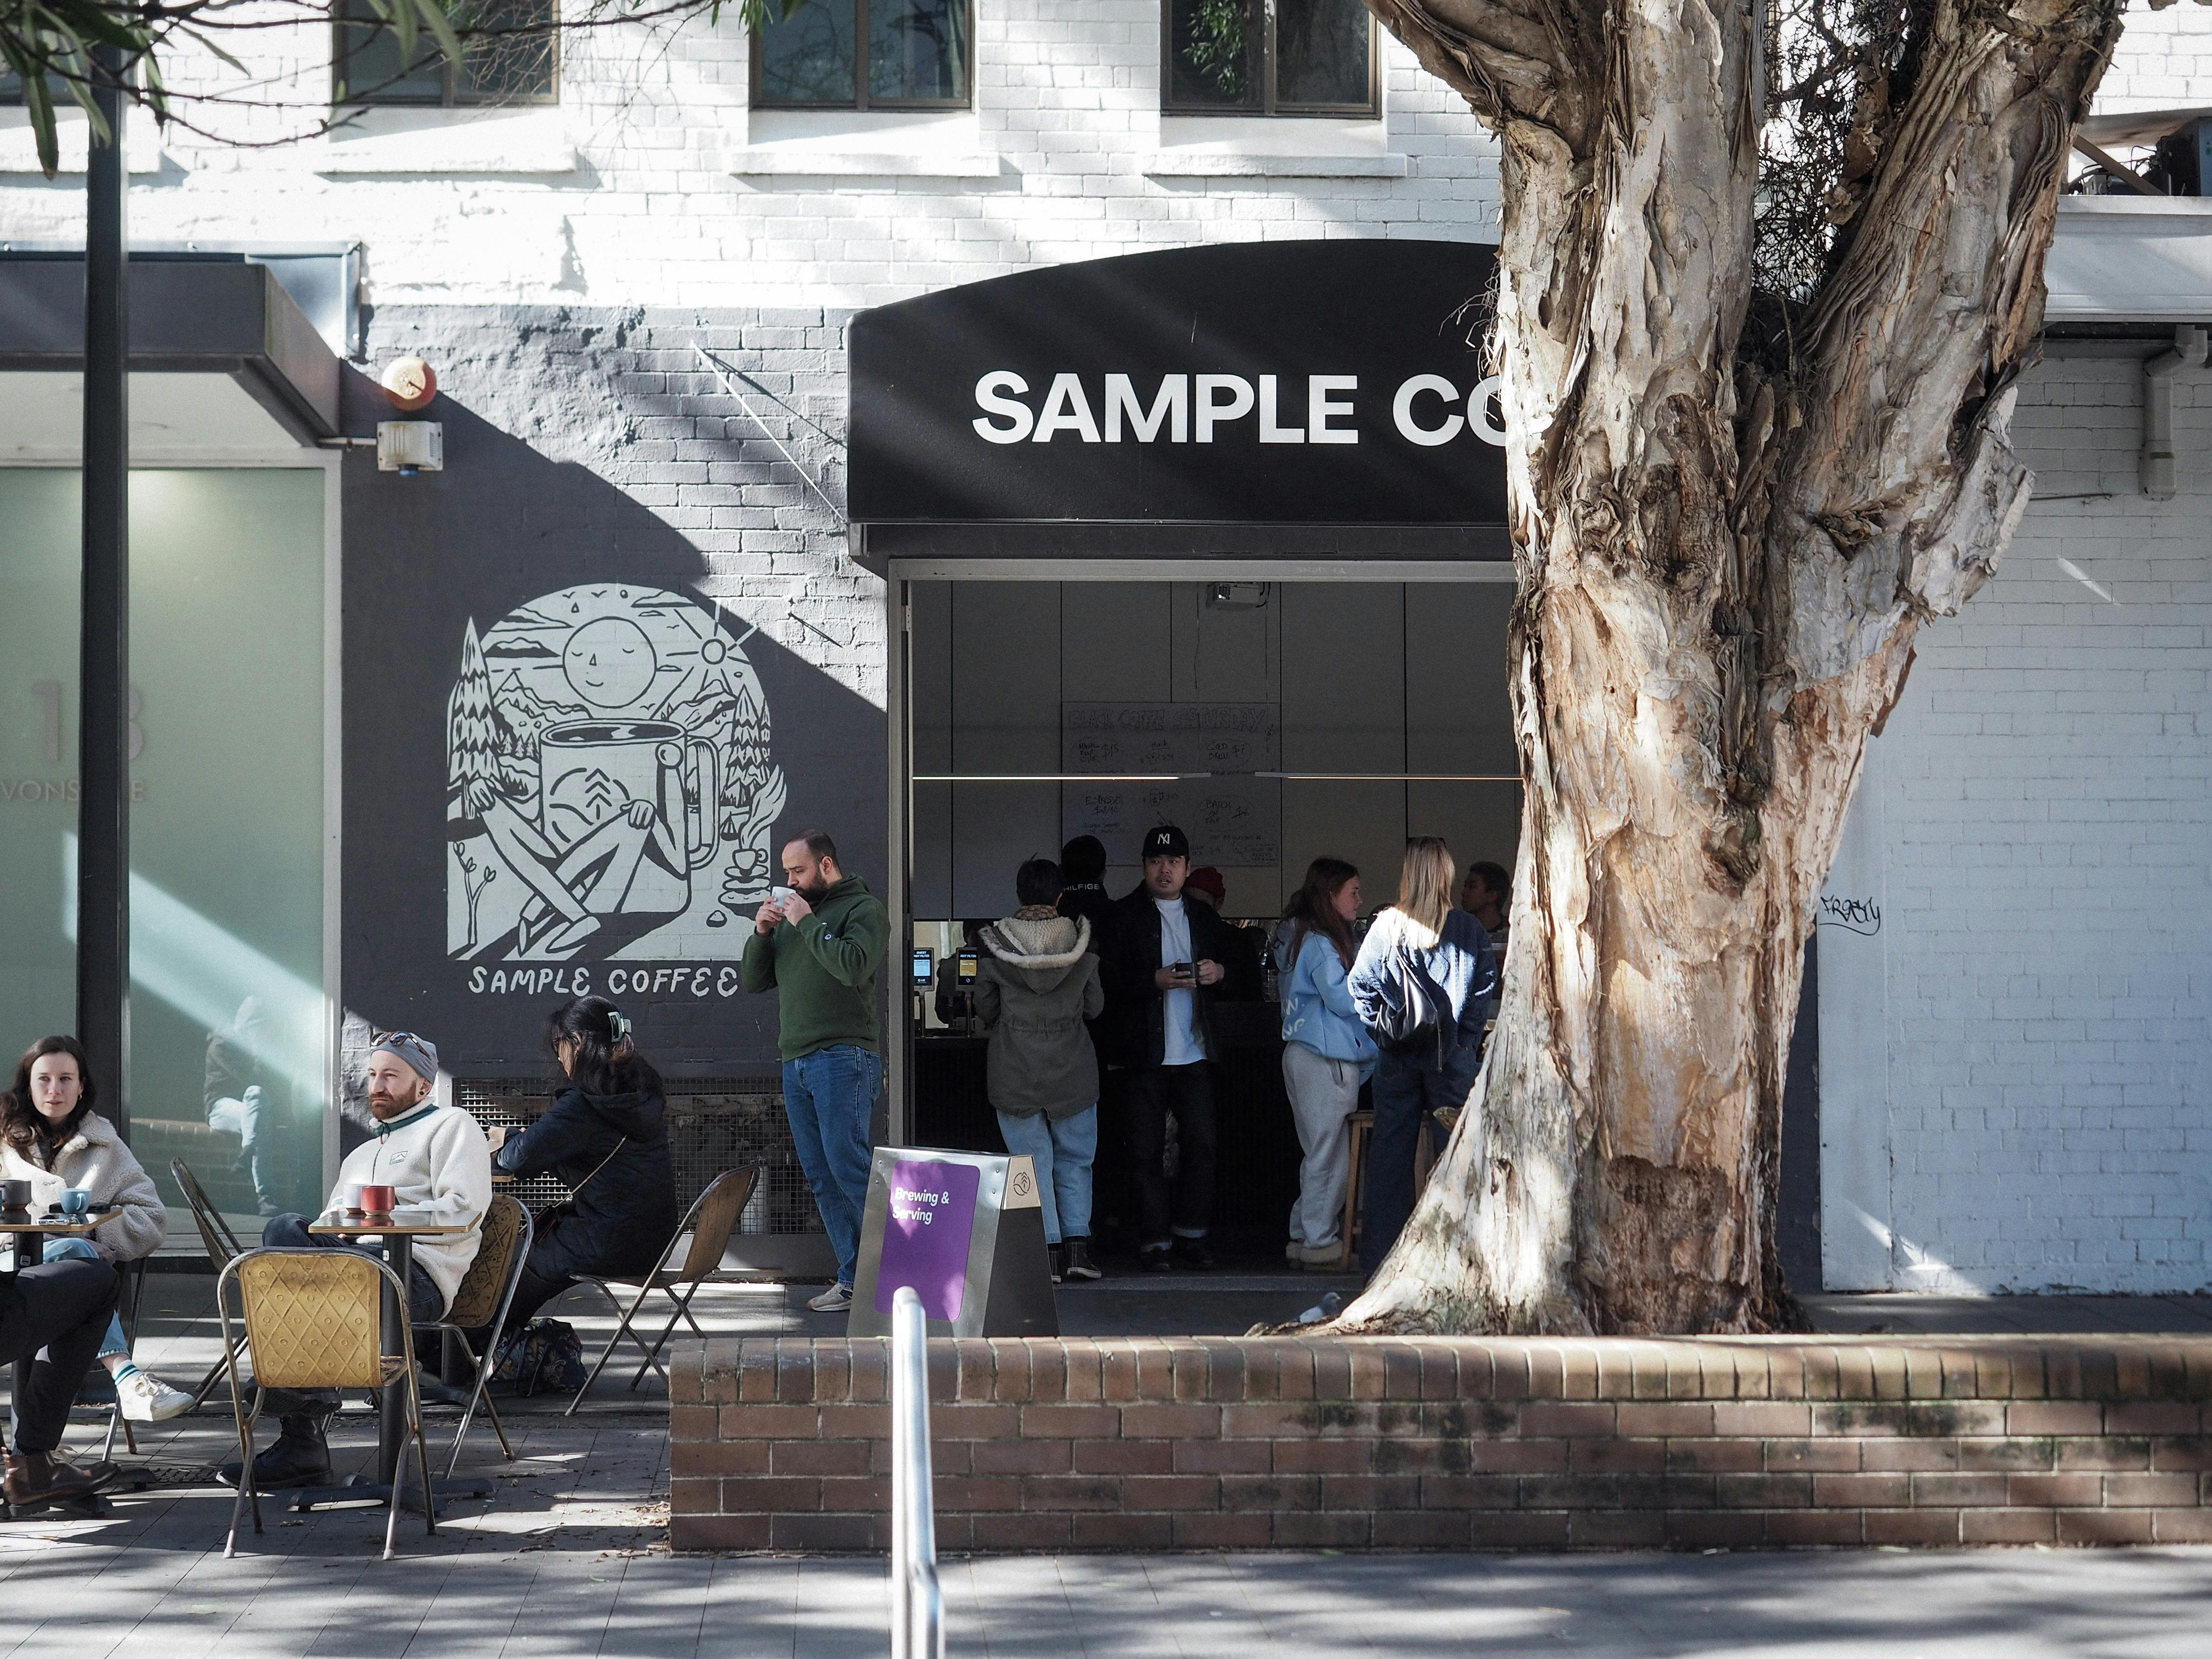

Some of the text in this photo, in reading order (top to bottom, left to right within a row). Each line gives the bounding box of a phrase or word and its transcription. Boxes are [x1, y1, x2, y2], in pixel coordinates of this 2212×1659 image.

[972, 370, 1358, 445] SAMPLE
[1063, 883, 1100, 892] HILFIGE
[468, 966, 738, 998] SAMPLE COFFEE
[894, 1187, 950, 1206] Brewing &
[892, 1207, 933, 1225] Serving
